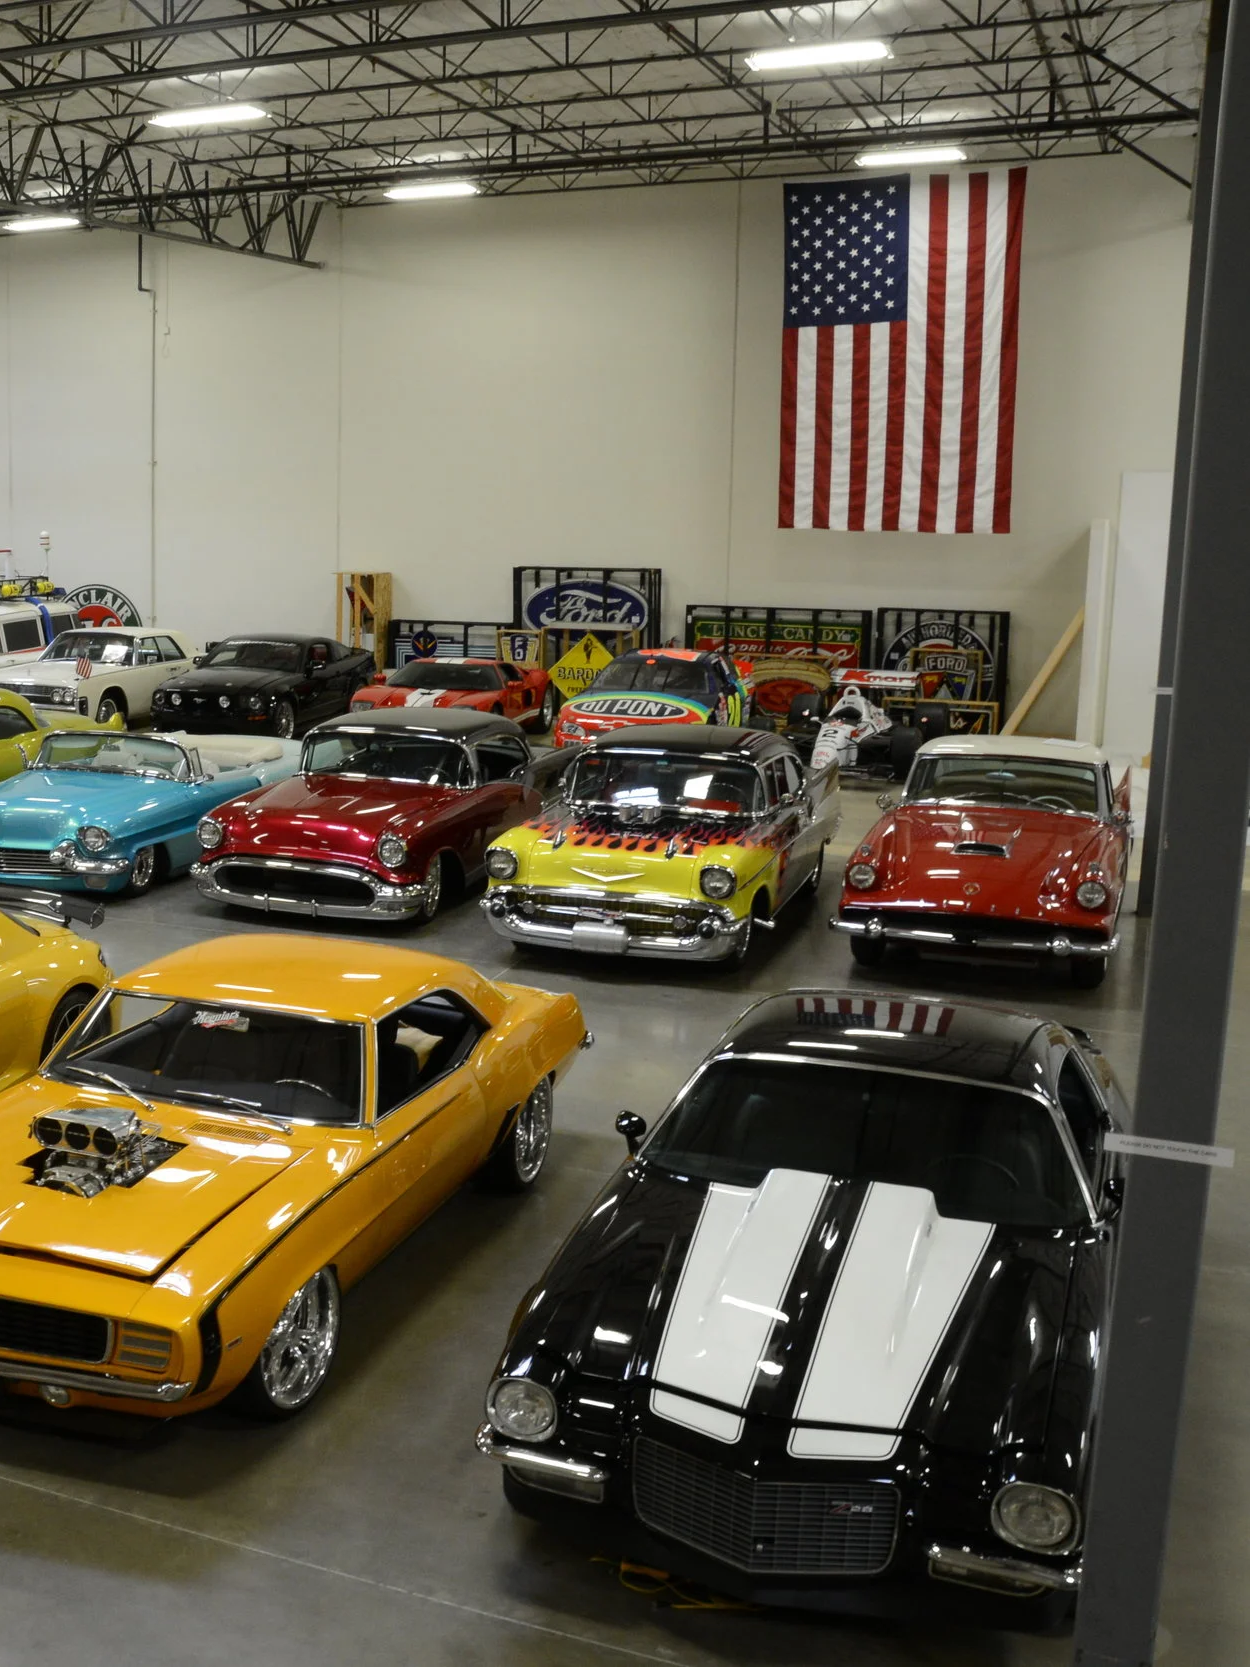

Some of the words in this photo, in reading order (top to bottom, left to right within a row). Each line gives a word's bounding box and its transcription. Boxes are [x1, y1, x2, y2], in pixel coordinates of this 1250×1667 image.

[67, 589, 132, 623] NCLAIR
[514, 637, 525, 660] FO
[929, 657, 964, 671] FORD
[557, 667, 602, 686] BARDA
[611, 700, 678, 716] PONT
[822, 729, 838, 738] 2
